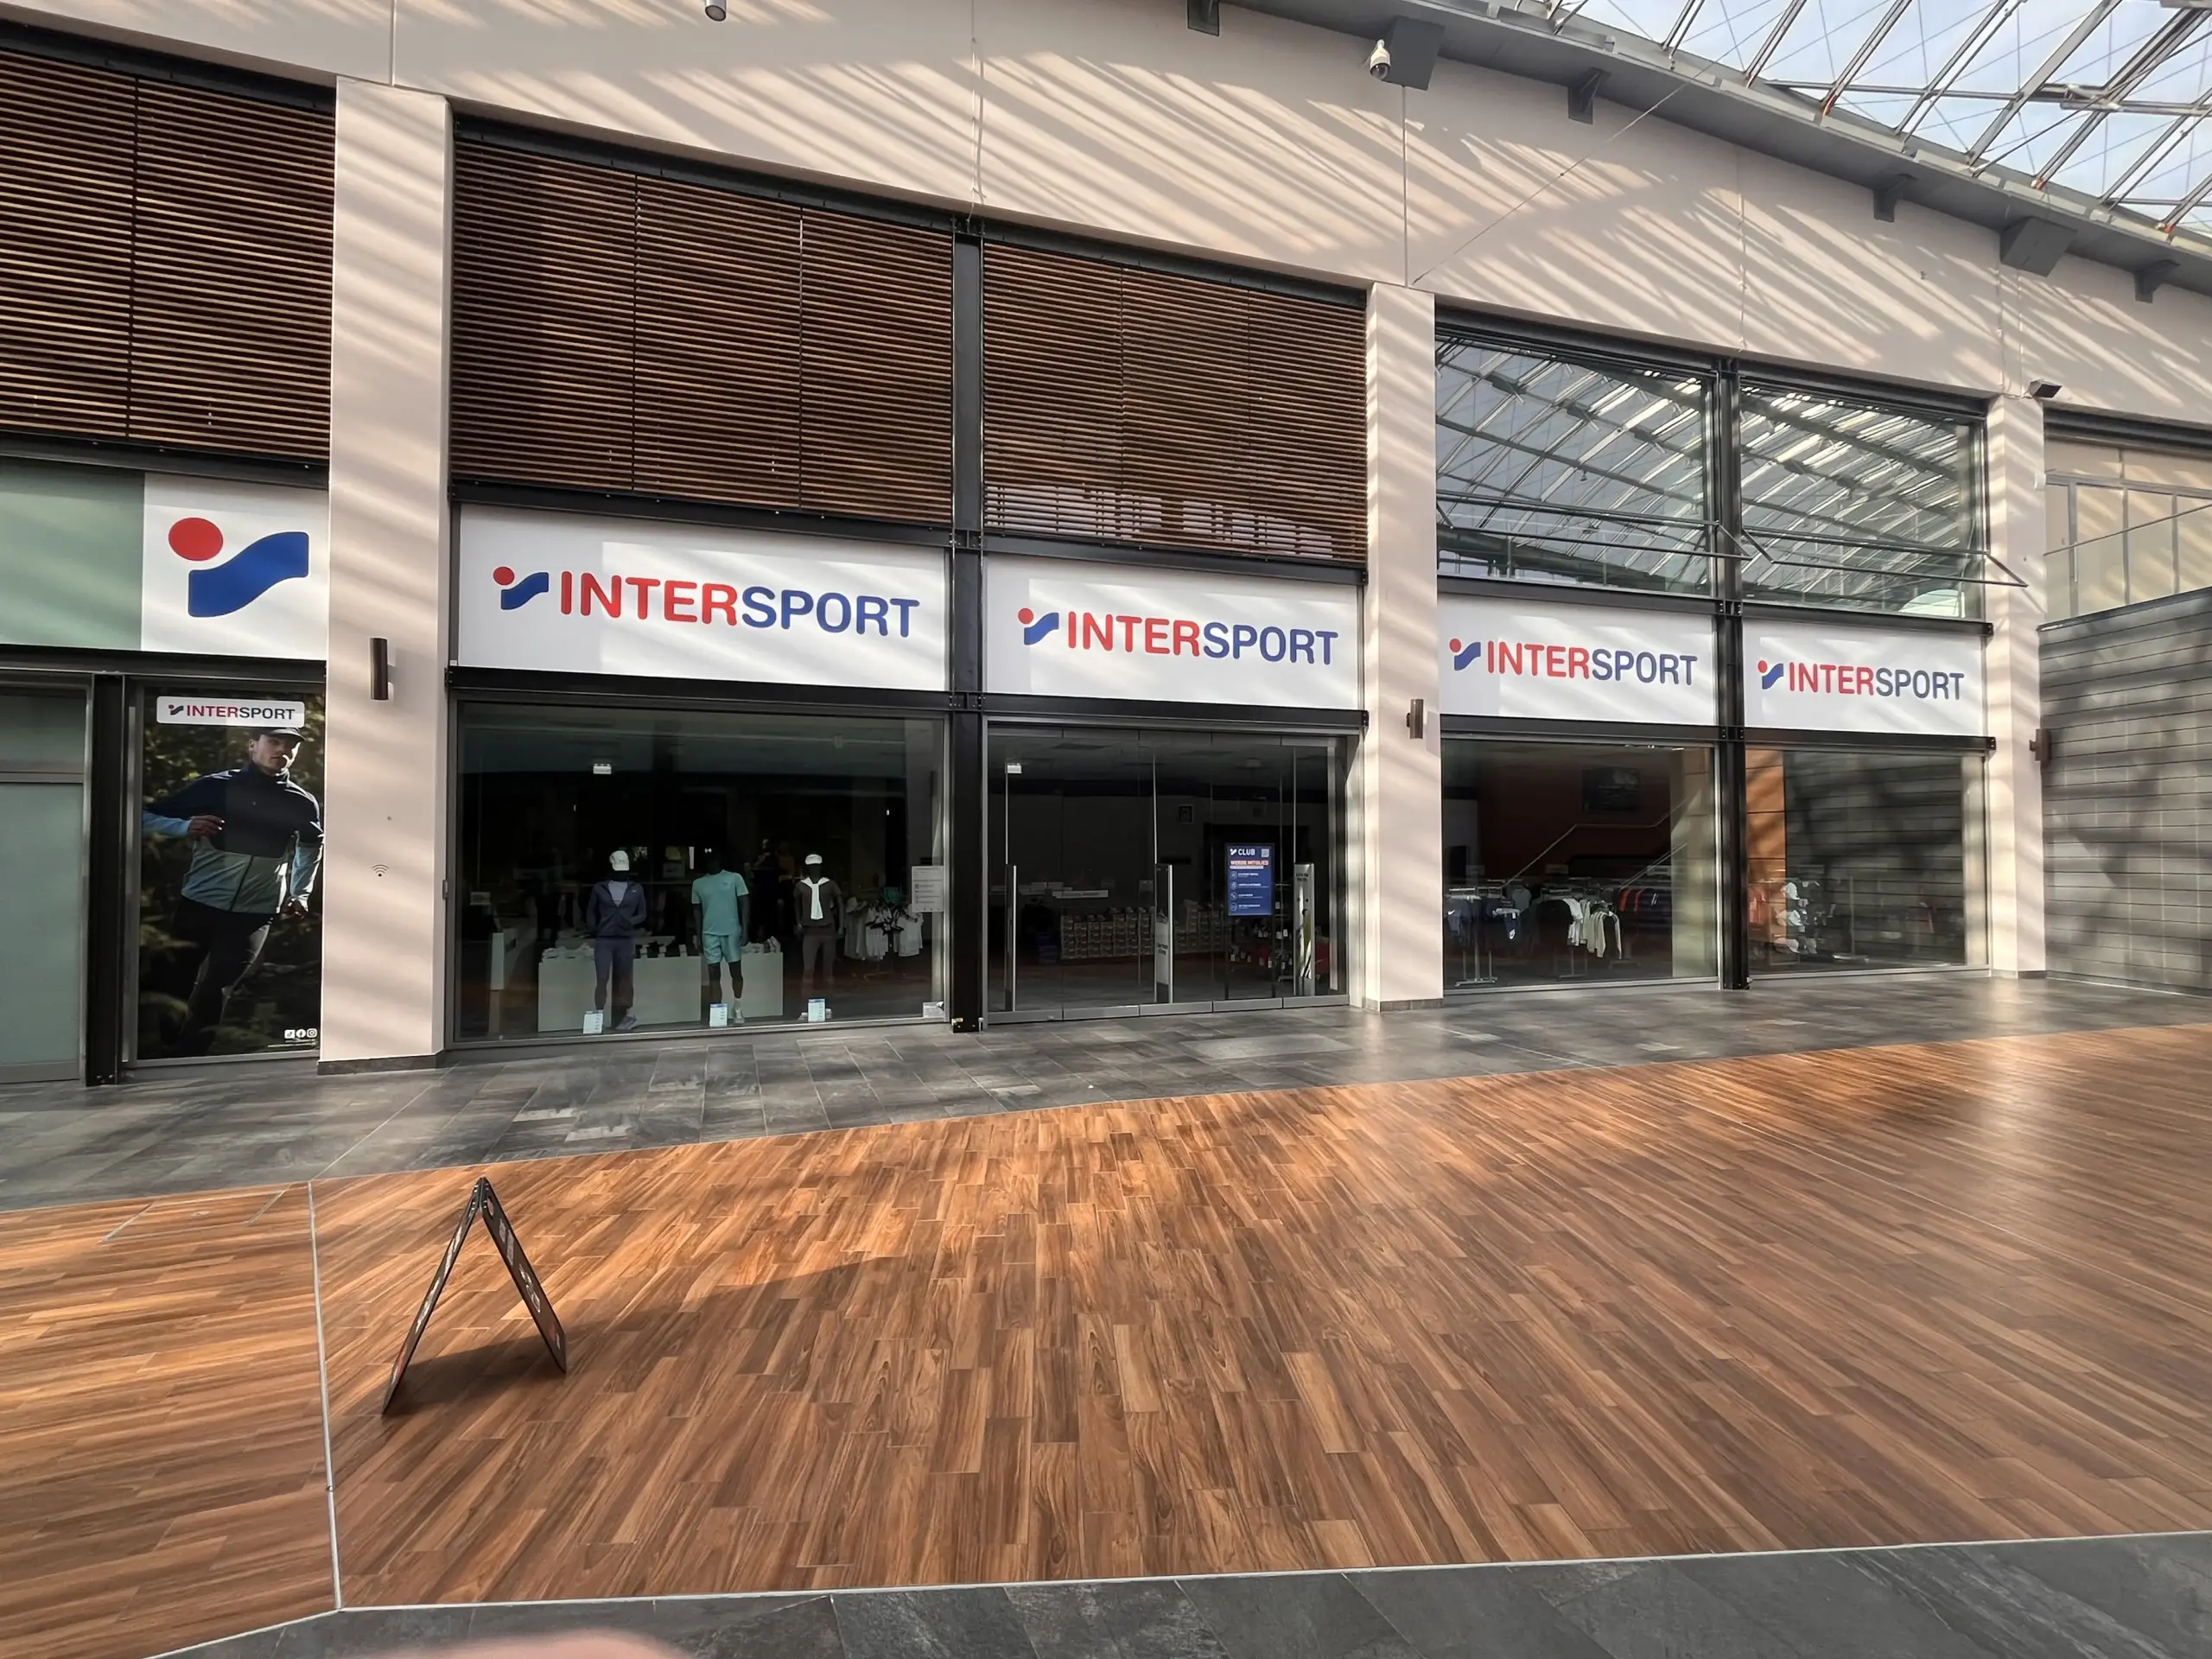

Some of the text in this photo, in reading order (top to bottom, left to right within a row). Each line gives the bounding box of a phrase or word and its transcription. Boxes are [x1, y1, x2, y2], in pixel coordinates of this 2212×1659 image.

[560, 570, 920, 639] INTERSPORT
[1067, 610, 1339, 666] INTERSPORT
[1486, 640, 1698, 686] INTERSPORT
[1788, 661, 1966, 701] INTERSPORT
[186, 704, 296, 720] INTERSPORT
